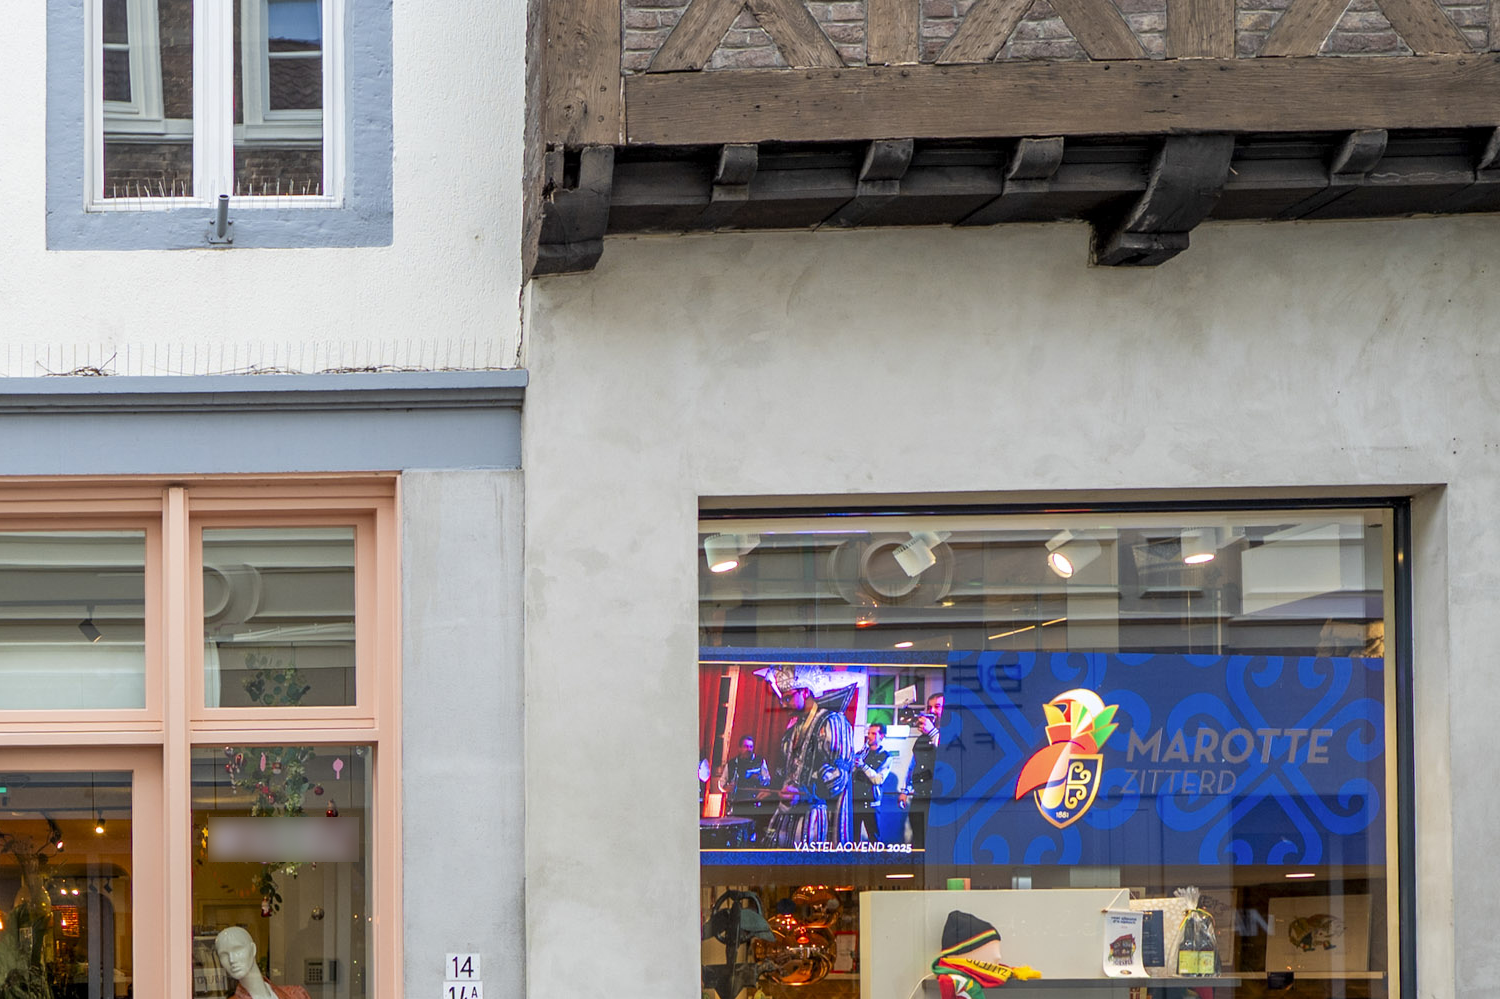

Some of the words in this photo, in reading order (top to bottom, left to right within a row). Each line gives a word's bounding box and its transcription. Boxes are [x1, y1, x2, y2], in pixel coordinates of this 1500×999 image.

[1125, 727, 1333, 765] MAROTTE
[1120, 769, 1237, 795] ZITTERD
[886, 843, 912, 854] 2025
[452, 956, 474, 978] 14
